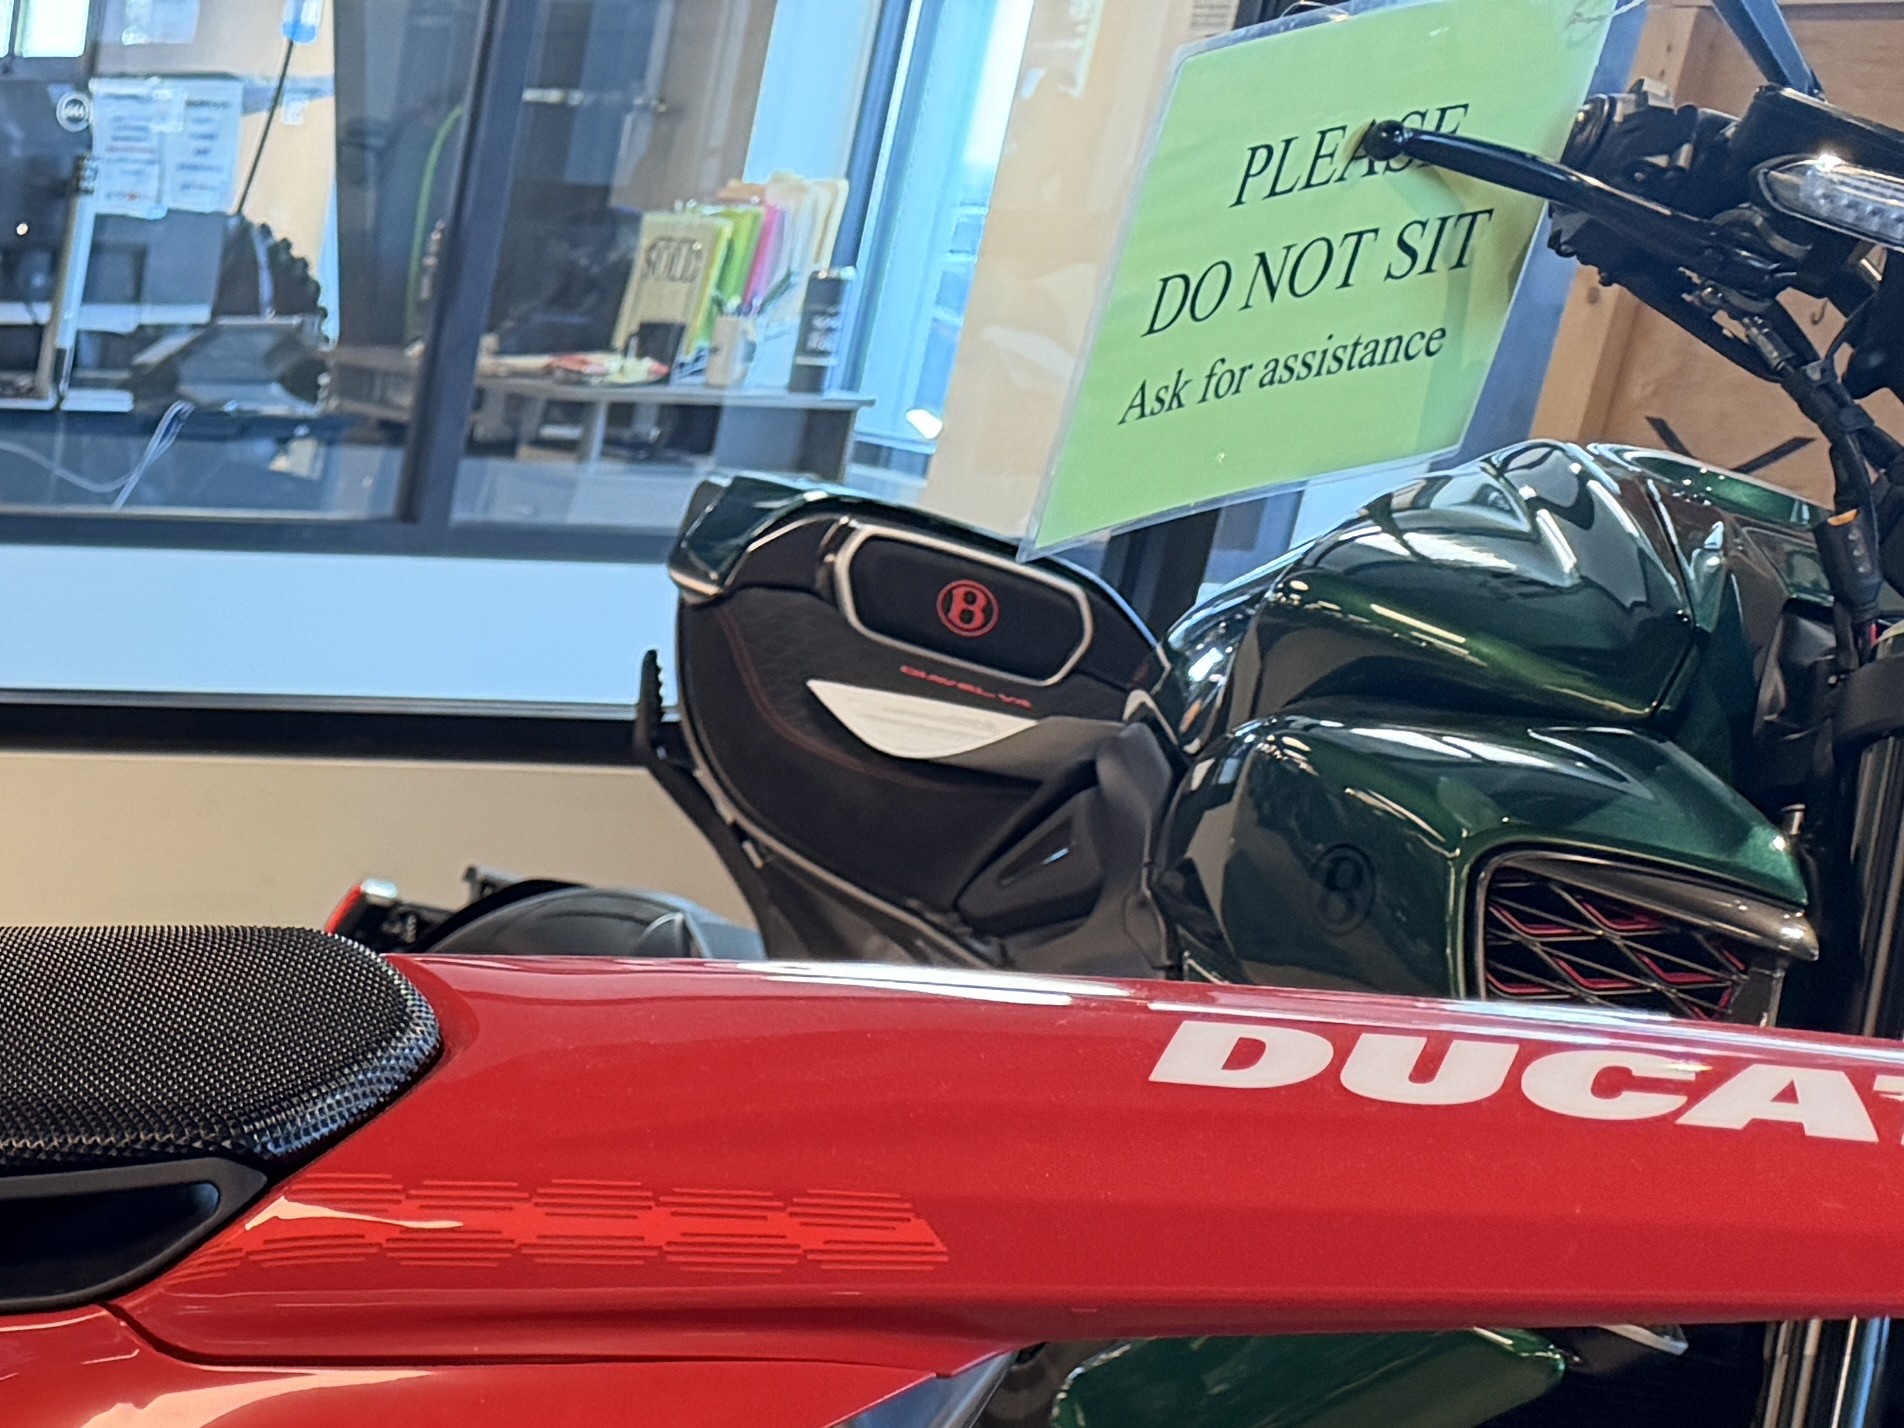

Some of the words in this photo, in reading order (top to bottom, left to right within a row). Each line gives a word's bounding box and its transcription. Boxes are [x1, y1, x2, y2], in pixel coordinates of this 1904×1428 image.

[1140, 259, 1233, 339] DO
[1237, 227, 1381, 312] NOT
[1383, 207, 1495, 283] SIT
[1117, 367, 1193, 425] Ask
[1196, 356, 1253, 405] for
[1257, 325, 1448, 389] assistance
[1150, 1019, 1904, 1145] DUCA
